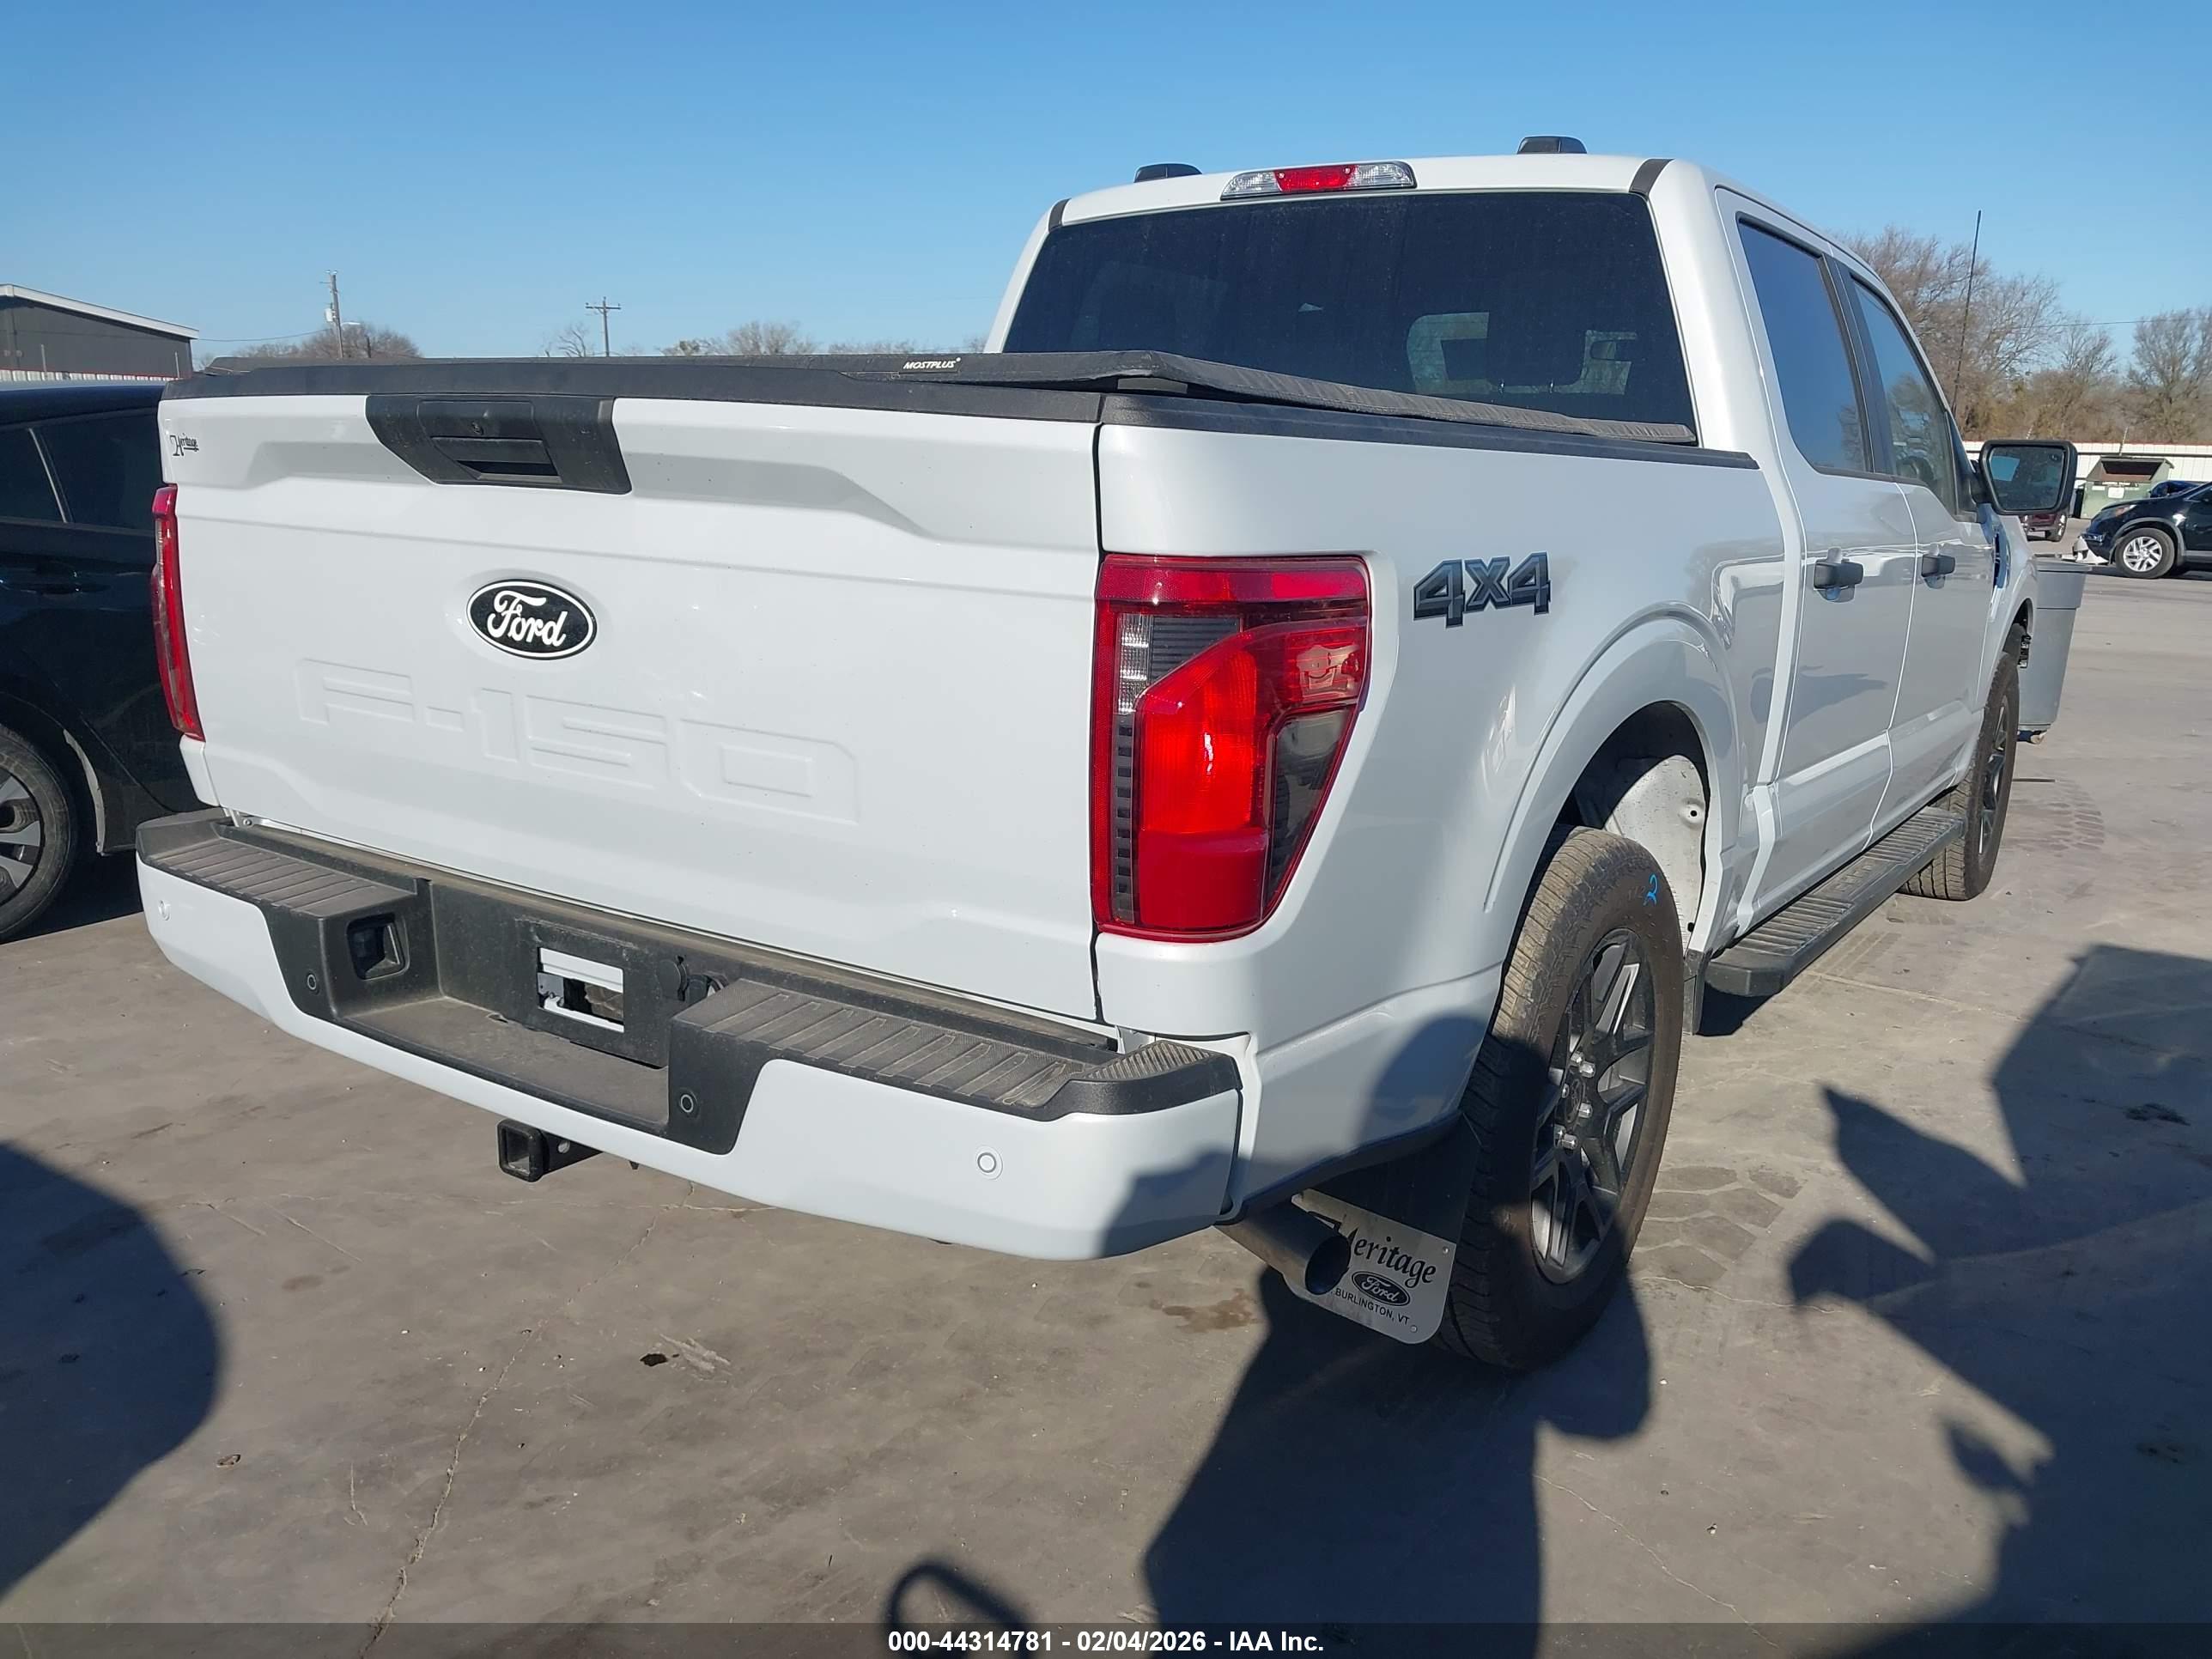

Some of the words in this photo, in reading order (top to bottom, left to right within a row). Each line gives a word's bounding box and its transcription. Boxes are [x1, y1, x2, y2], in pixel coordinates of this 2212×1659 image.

[902, 360, 957, 369] MOSTPLUS
[486, 589, 568, 649] Ford
[295, 657, 862, 825] F-150
[1347, 1228, 1437, 1289] eritage
[1334, 1287, 1395, 1322] BURLINGTON,
[1397, 1313, 1410, 1325] VT
[1361, 1275, 1401, 1303] Ford
